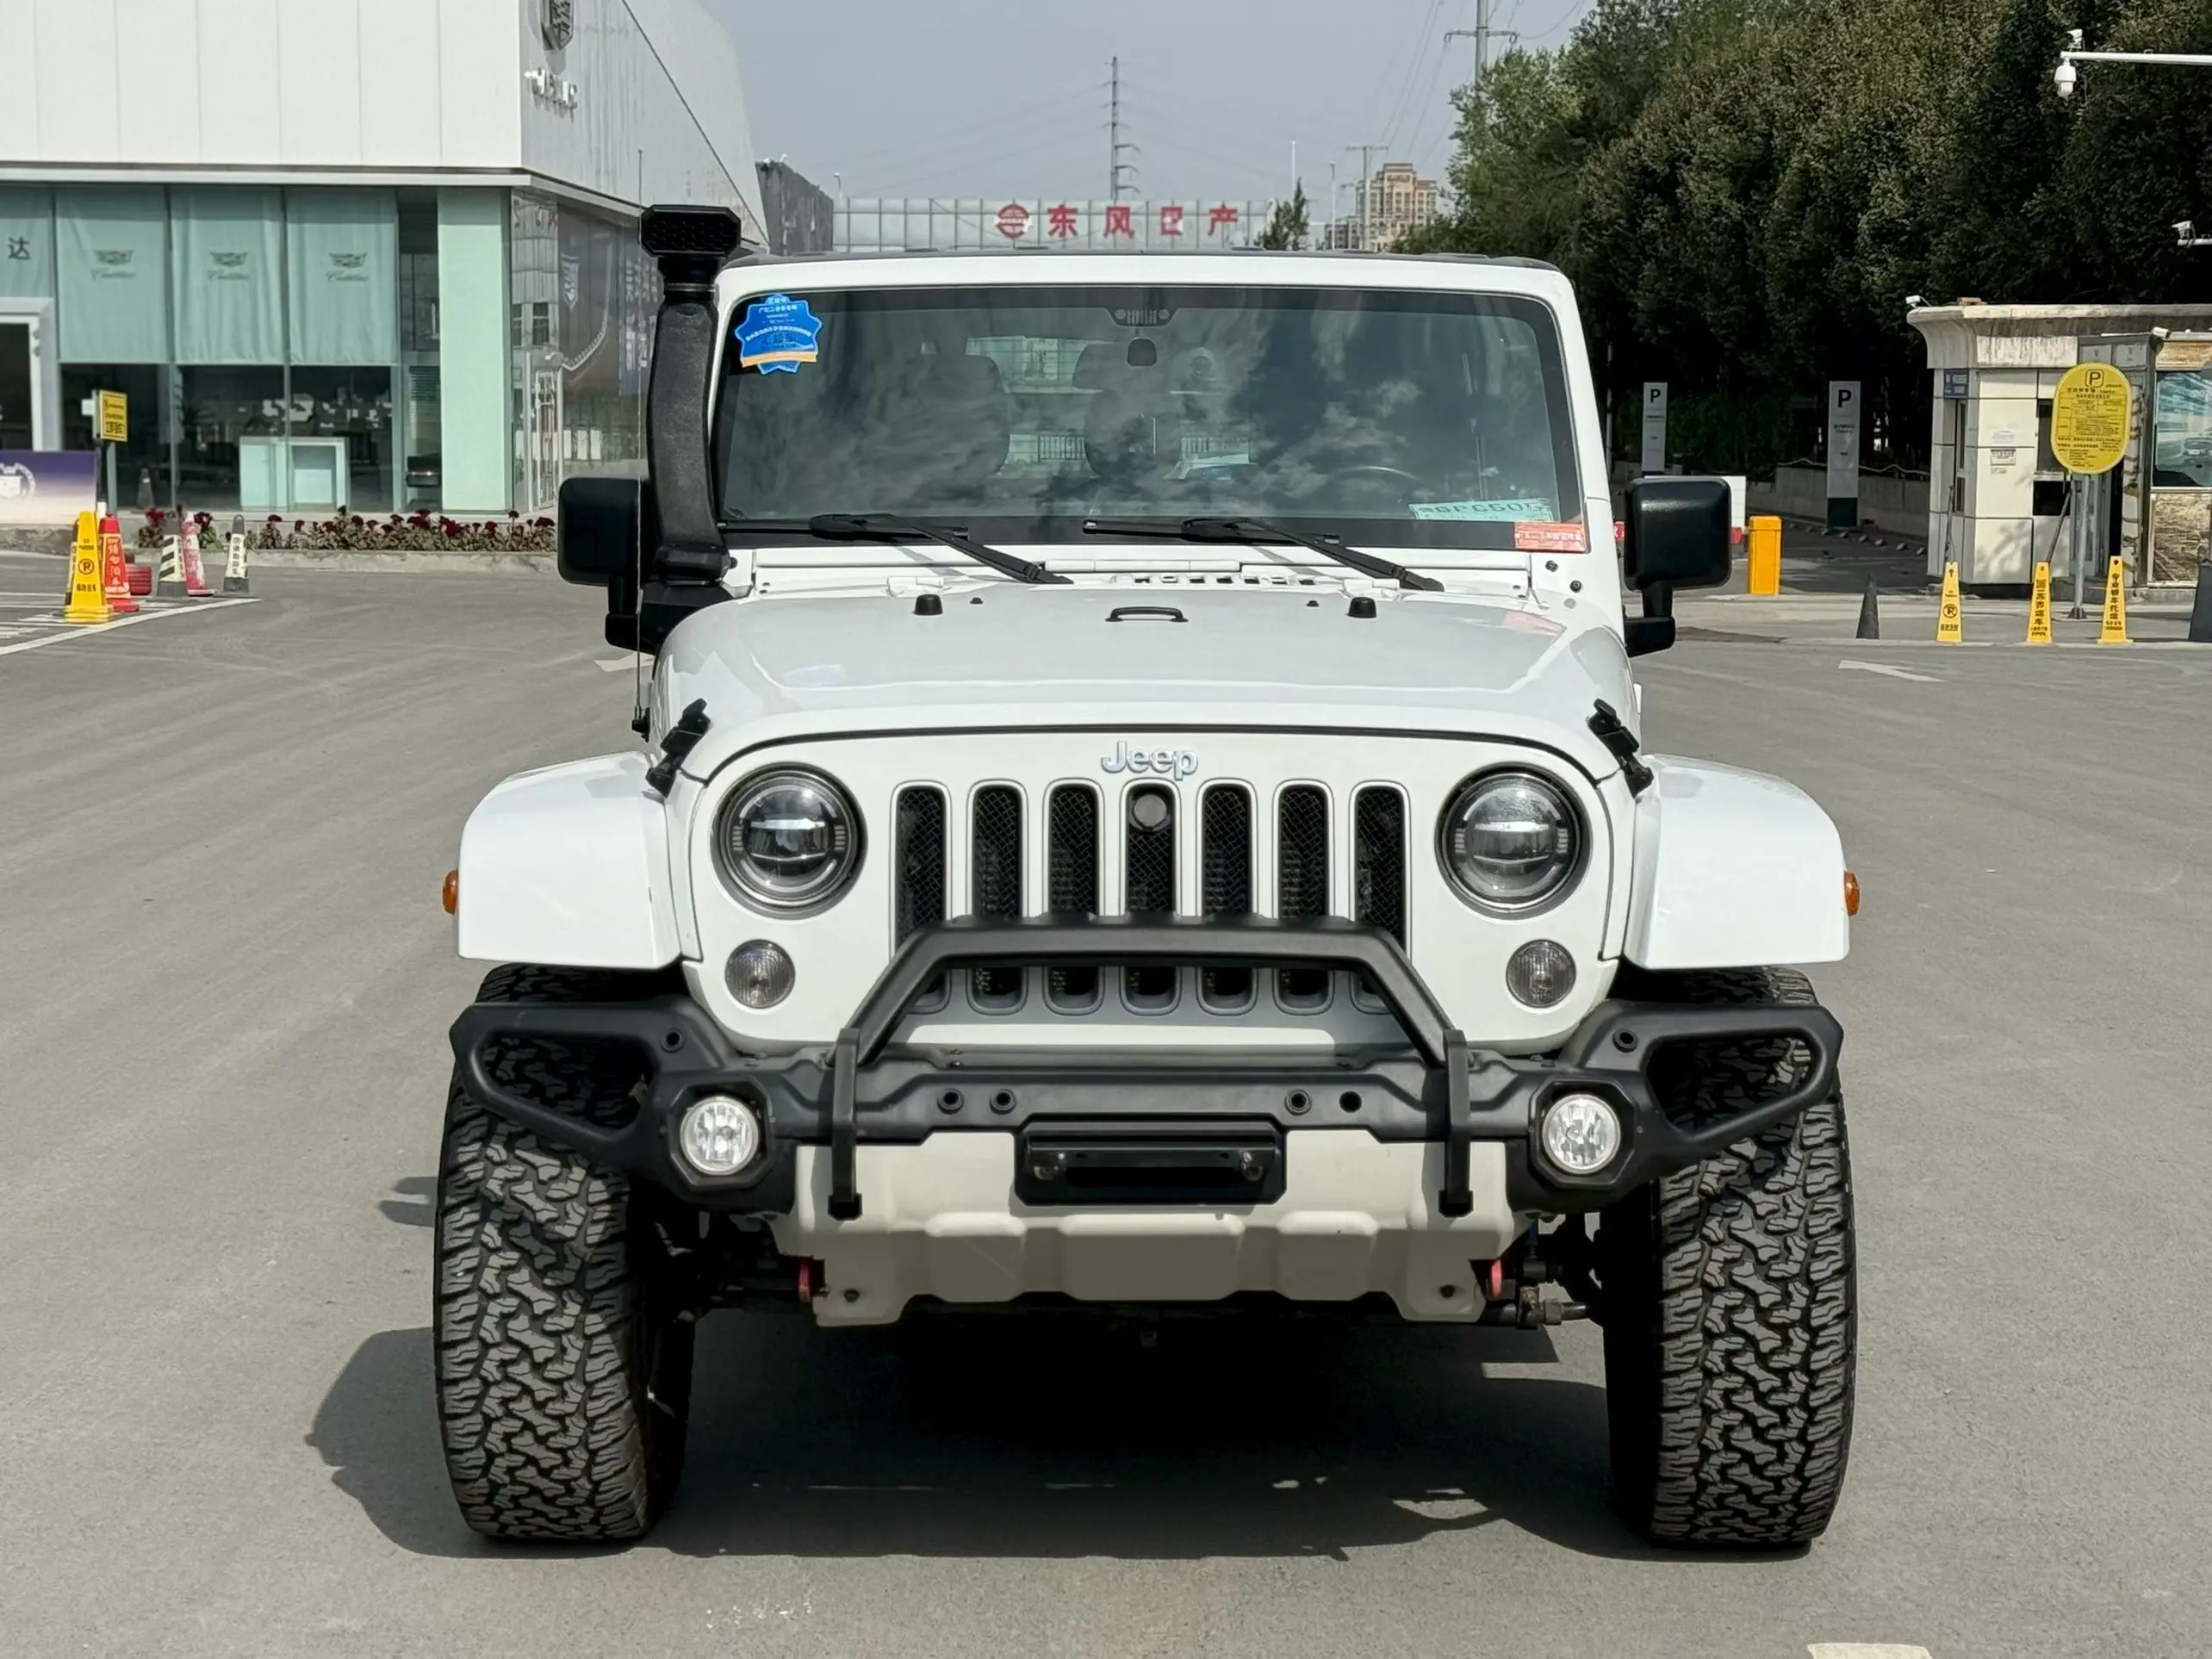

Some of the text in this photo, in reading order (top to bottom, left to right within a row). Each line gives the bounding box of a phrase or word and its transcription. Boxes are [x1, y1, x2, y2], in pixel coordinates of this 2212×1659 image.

[8, 235, 32, 260] 达
[2089, 371, 2101, 386] P
[1650, 388, 1661, 403] P
[1838, 389, 1852, 408] P
[1101, 741, 1198, 781] Jeep
